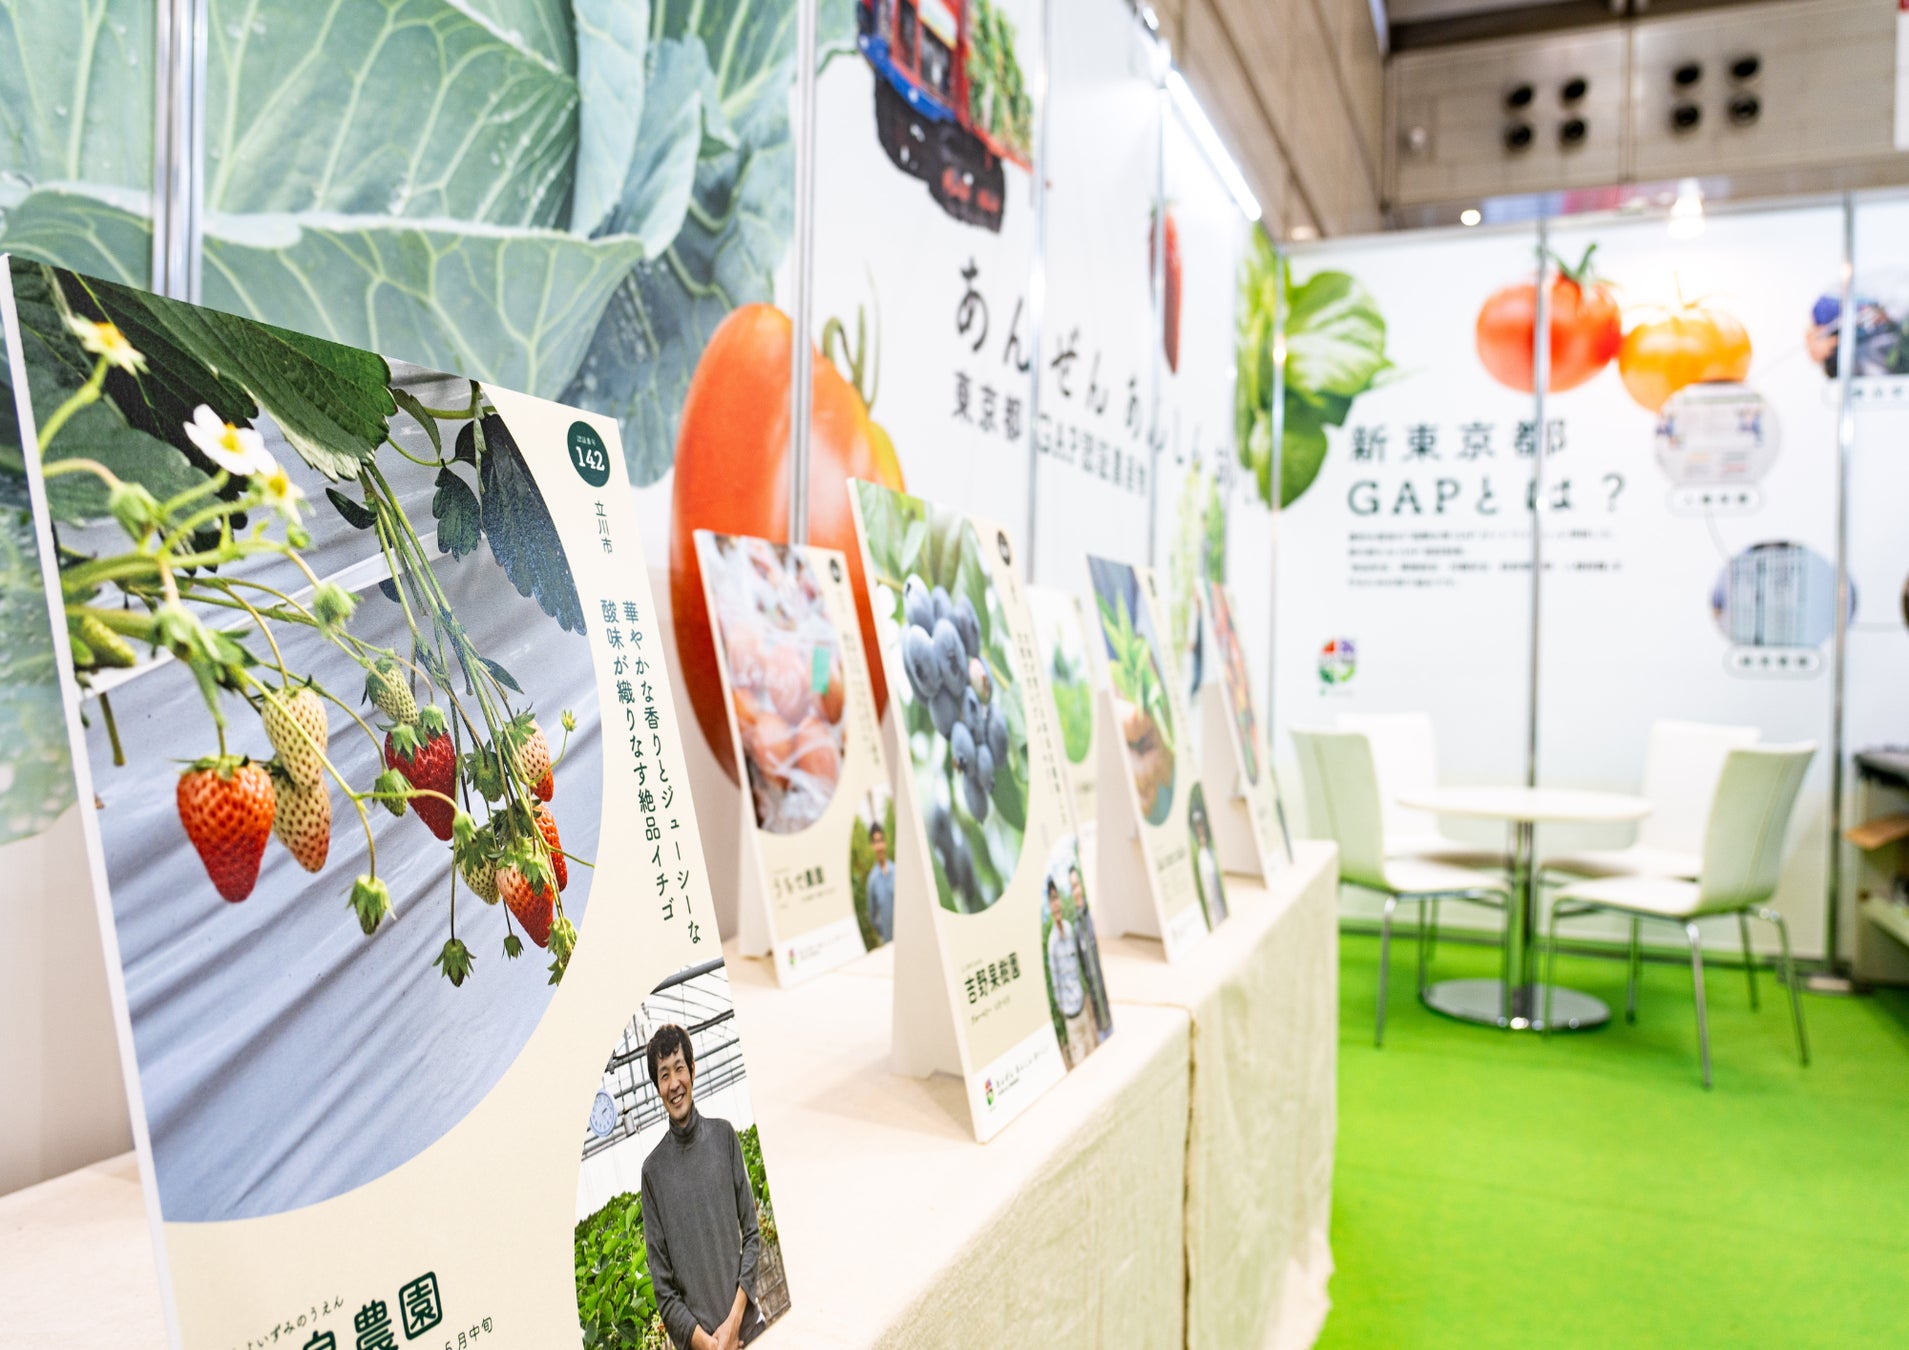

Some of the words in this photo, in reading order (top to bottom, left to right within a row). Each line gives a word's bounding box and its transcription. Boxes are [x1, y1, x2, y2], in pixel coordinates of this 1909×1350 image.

[575, 445, 606, 471] 142
[1351, 420, 1567, 462] 新東京都
[594, 500, 613, 554] 立川市
[600, 599, 675, 922] 酸味が織りなす絶品イチゴ
[622, 600, 702, 944] 華やかな香りとジューシーな
